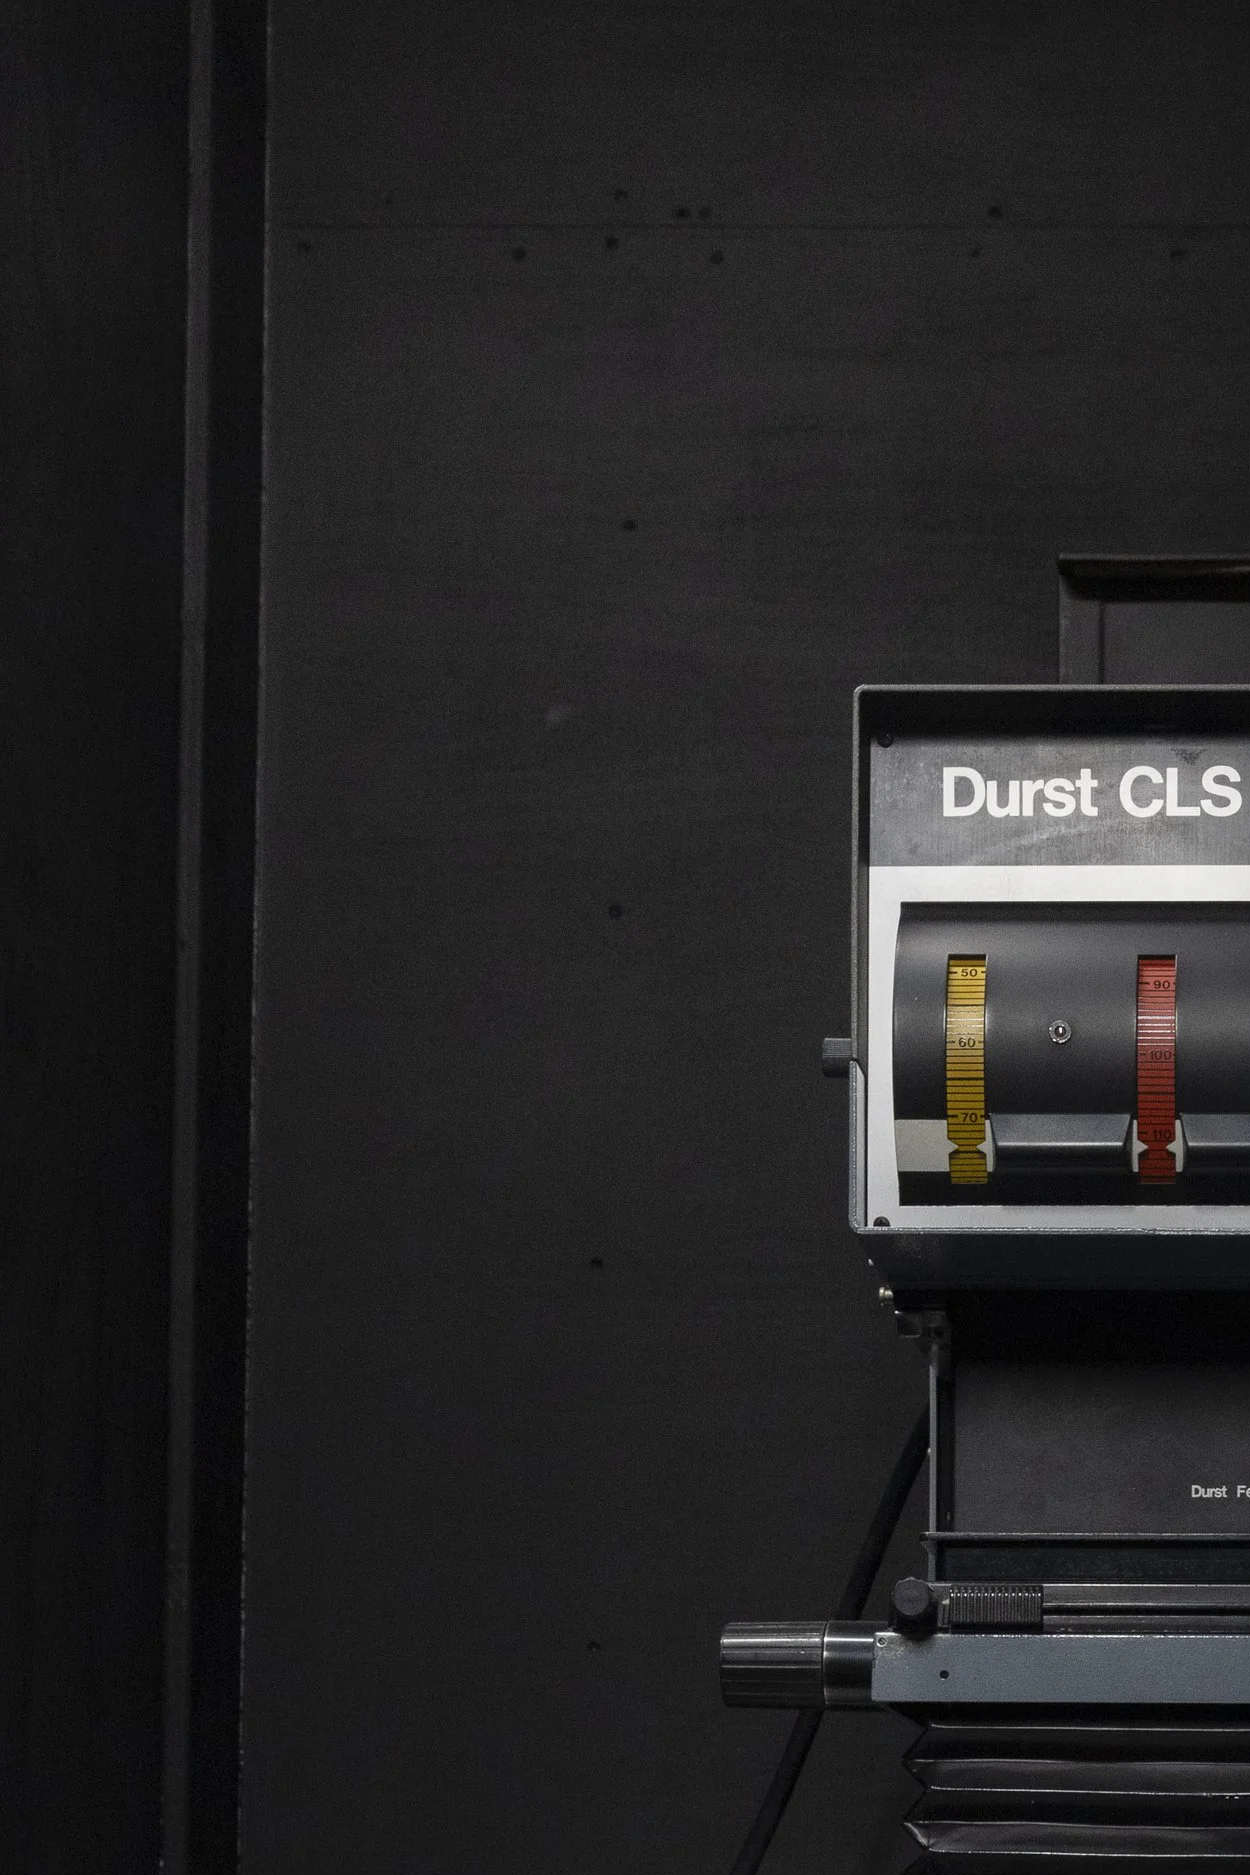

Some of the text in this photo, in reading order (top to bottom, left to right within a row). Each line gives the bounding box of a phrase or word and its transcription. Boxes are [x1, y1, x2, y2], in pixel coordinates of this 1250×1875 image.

[943, 768, 1098, 817] Durst
[1119, 766, 1242, 817] CLS
[961, 969, 978, 977] 50
[1153, 980, 1170, 989] 90
[958, 1037, 976, 1048] 60
[1150, 1050, 1172, 1061] 100
[962, 1112, 978, 1123] 70
[1191, 1485, 1227, 1498] Durst
